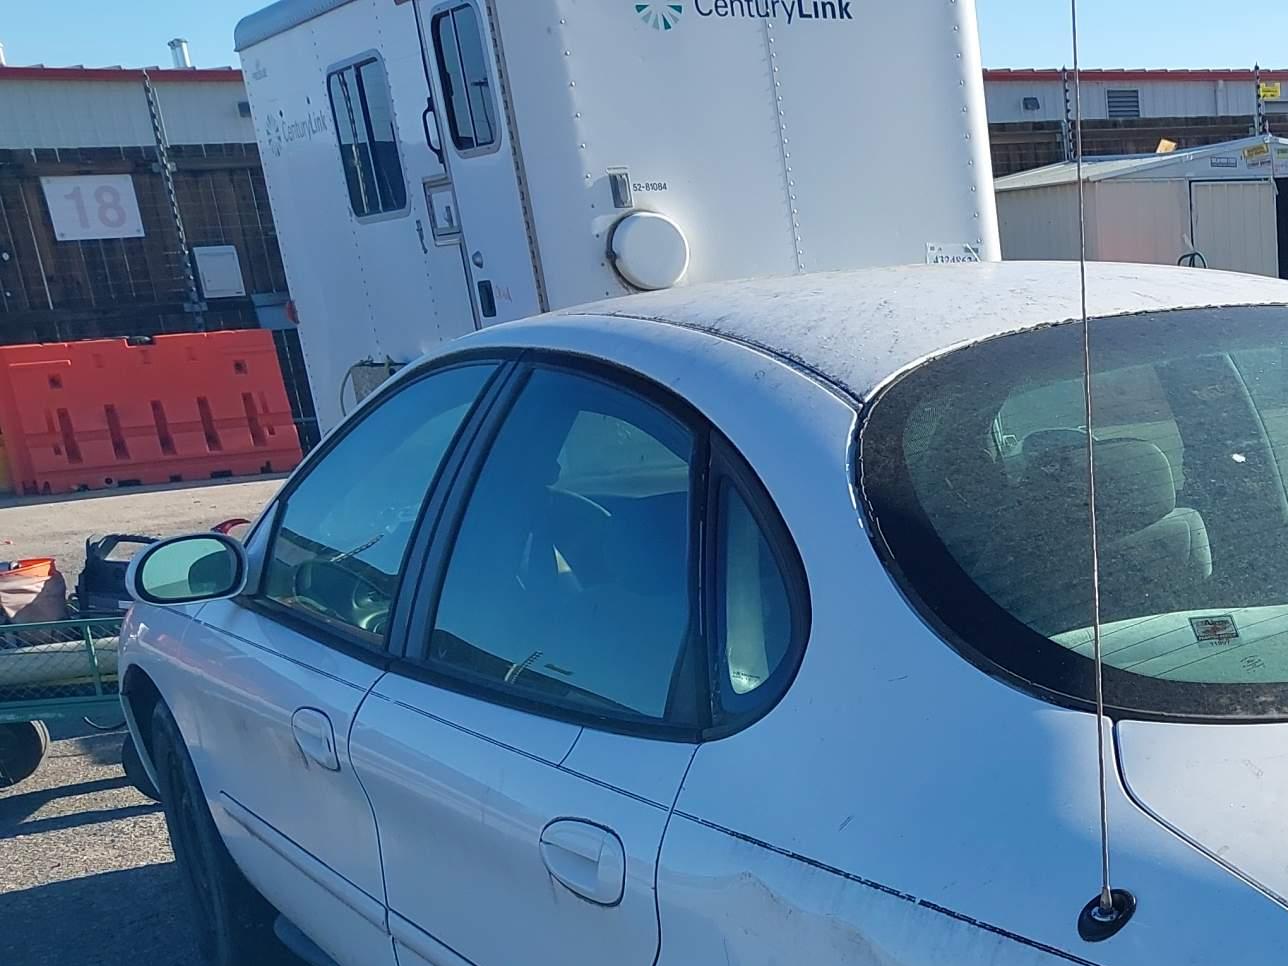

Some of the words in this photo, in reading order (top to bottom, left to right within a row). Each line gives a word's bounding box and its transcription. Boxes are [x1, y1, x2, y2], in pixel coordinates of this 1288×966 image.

[694, 0, 852, 24] CenturyLink
[281, 109, 327, 143] CenturyLink
[632, 182, 668, 192] 52-81084
[63, 184, 127, 229] 18
